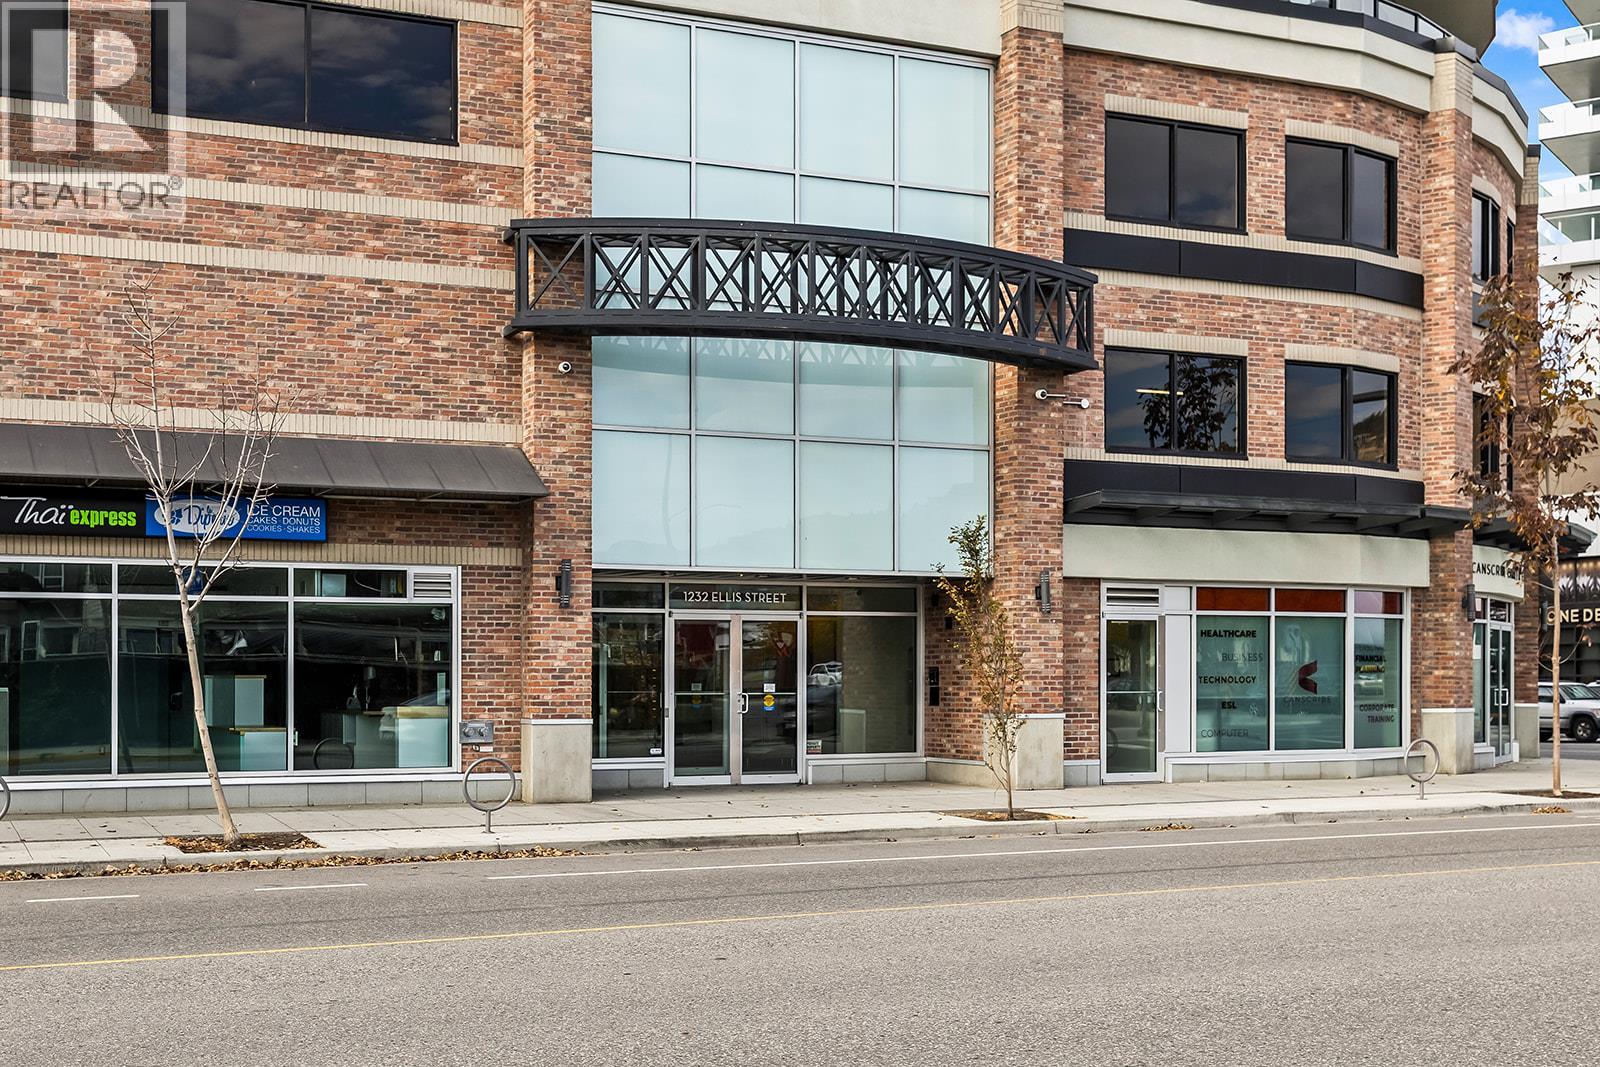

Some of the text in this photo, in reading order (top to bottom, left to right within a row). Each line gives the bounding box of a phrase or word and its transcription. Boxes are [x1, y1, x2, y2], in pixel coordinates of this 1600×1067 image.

[247, 504, 321, 518] ICE CREAM
[70, 509, 137, 528] express
[248, 516, 321, 526] CAKES DONUTS
[246, 524, 321, 534] COOKIES SHAKES
[683, 591, 787, 604] 1232 ELLIS STREET
[1200, 629, 1257, 638] HEALTHCARE
[1198, 676, 1257, 684] TECHNOLOGY
[1221, 701, 1237, 710] ESL
[1359, 703, 1396, 712] CORPORATE
[1367, 715, 1395, 723] TRAINING
[1200, 728, 1249, 738] COMPUTER
